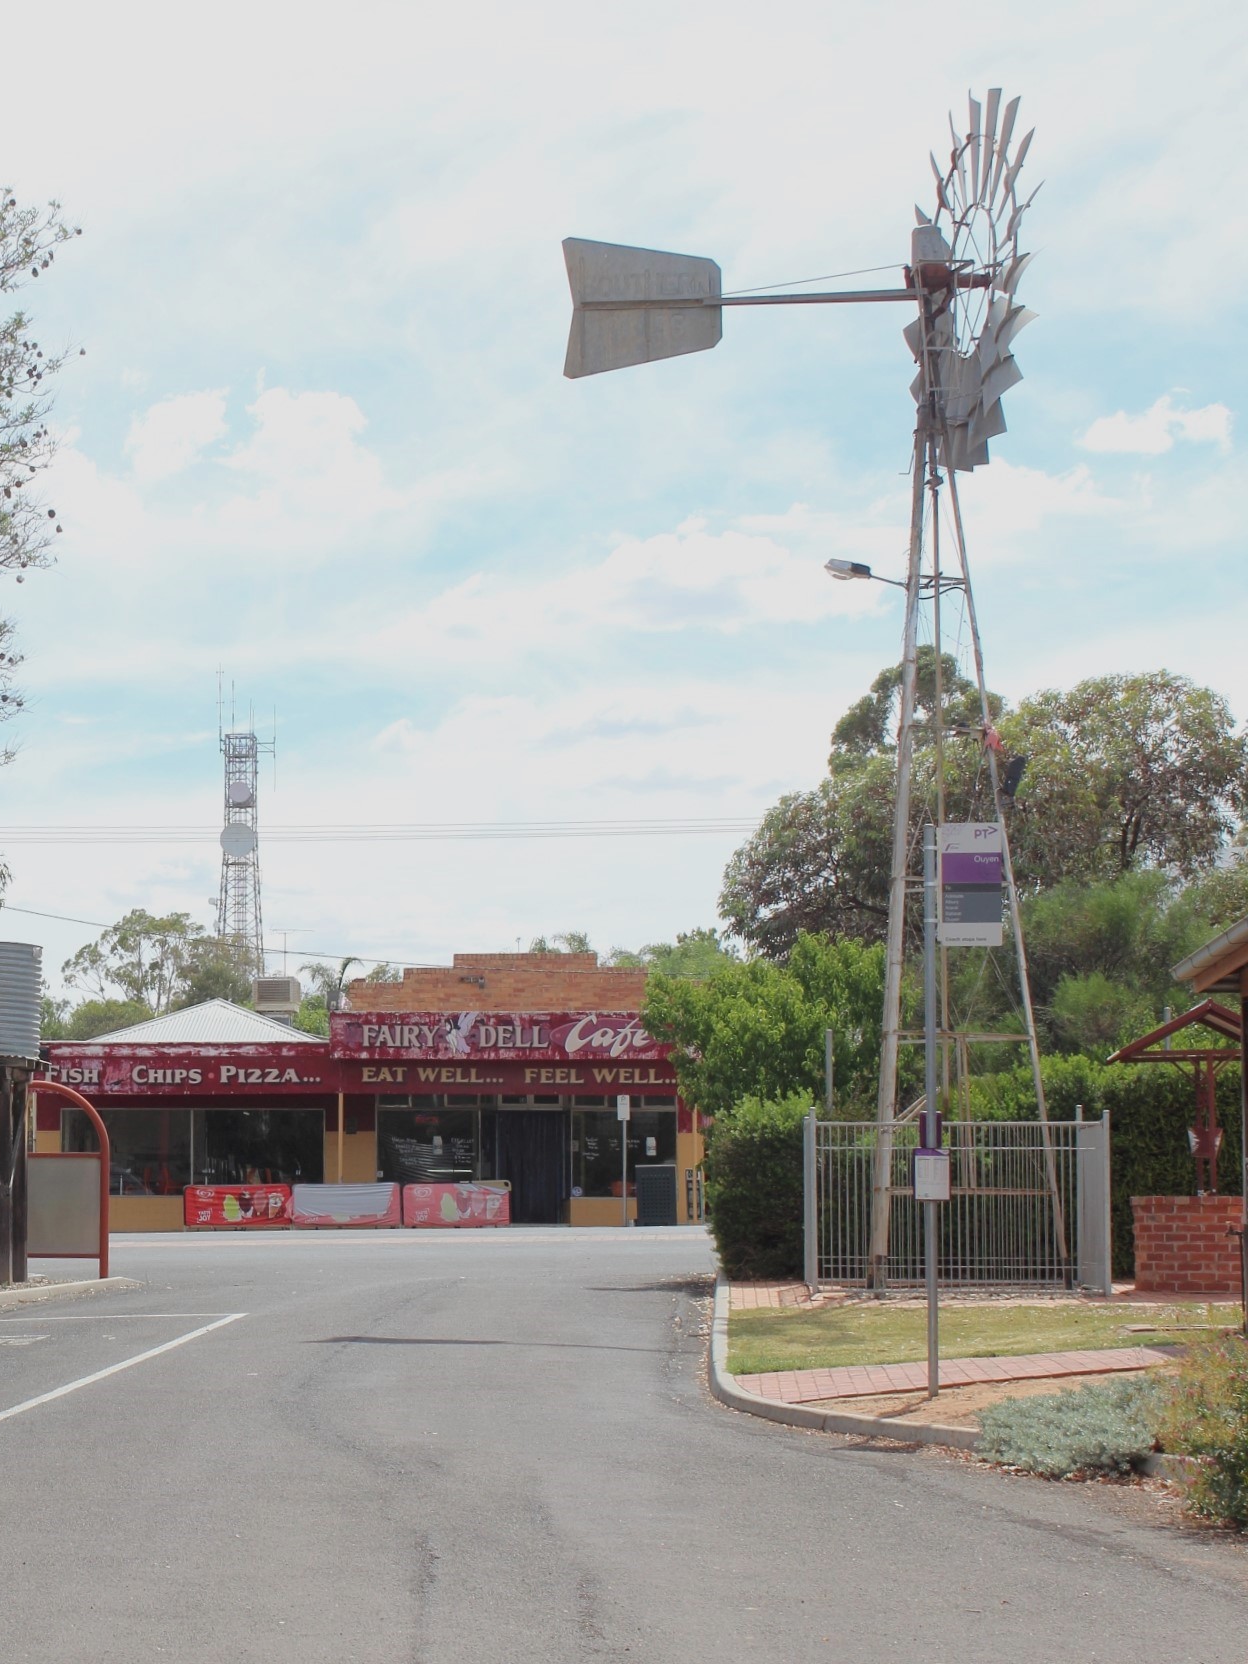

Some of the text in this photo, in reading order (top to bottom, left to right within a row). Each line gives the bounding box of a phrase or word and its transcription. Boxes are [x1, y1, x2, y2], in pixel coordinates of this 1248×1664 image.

[974, 855, 999, 864] Ouyen
[362, 1024, 440, 1048] FAIRY
[479, 1025, 549, 1048] DELL
[45, 1065, 99, 1083] FISH
[131, 1065, 202, 1084] CHIPS
[219, 1065, 321, 1083] PIZZA...
[361, 1066, 408, 1083] EAT
[416, 1066, 504, 1084] WELL...
[524, 1068, 584, 1084] FEEL
